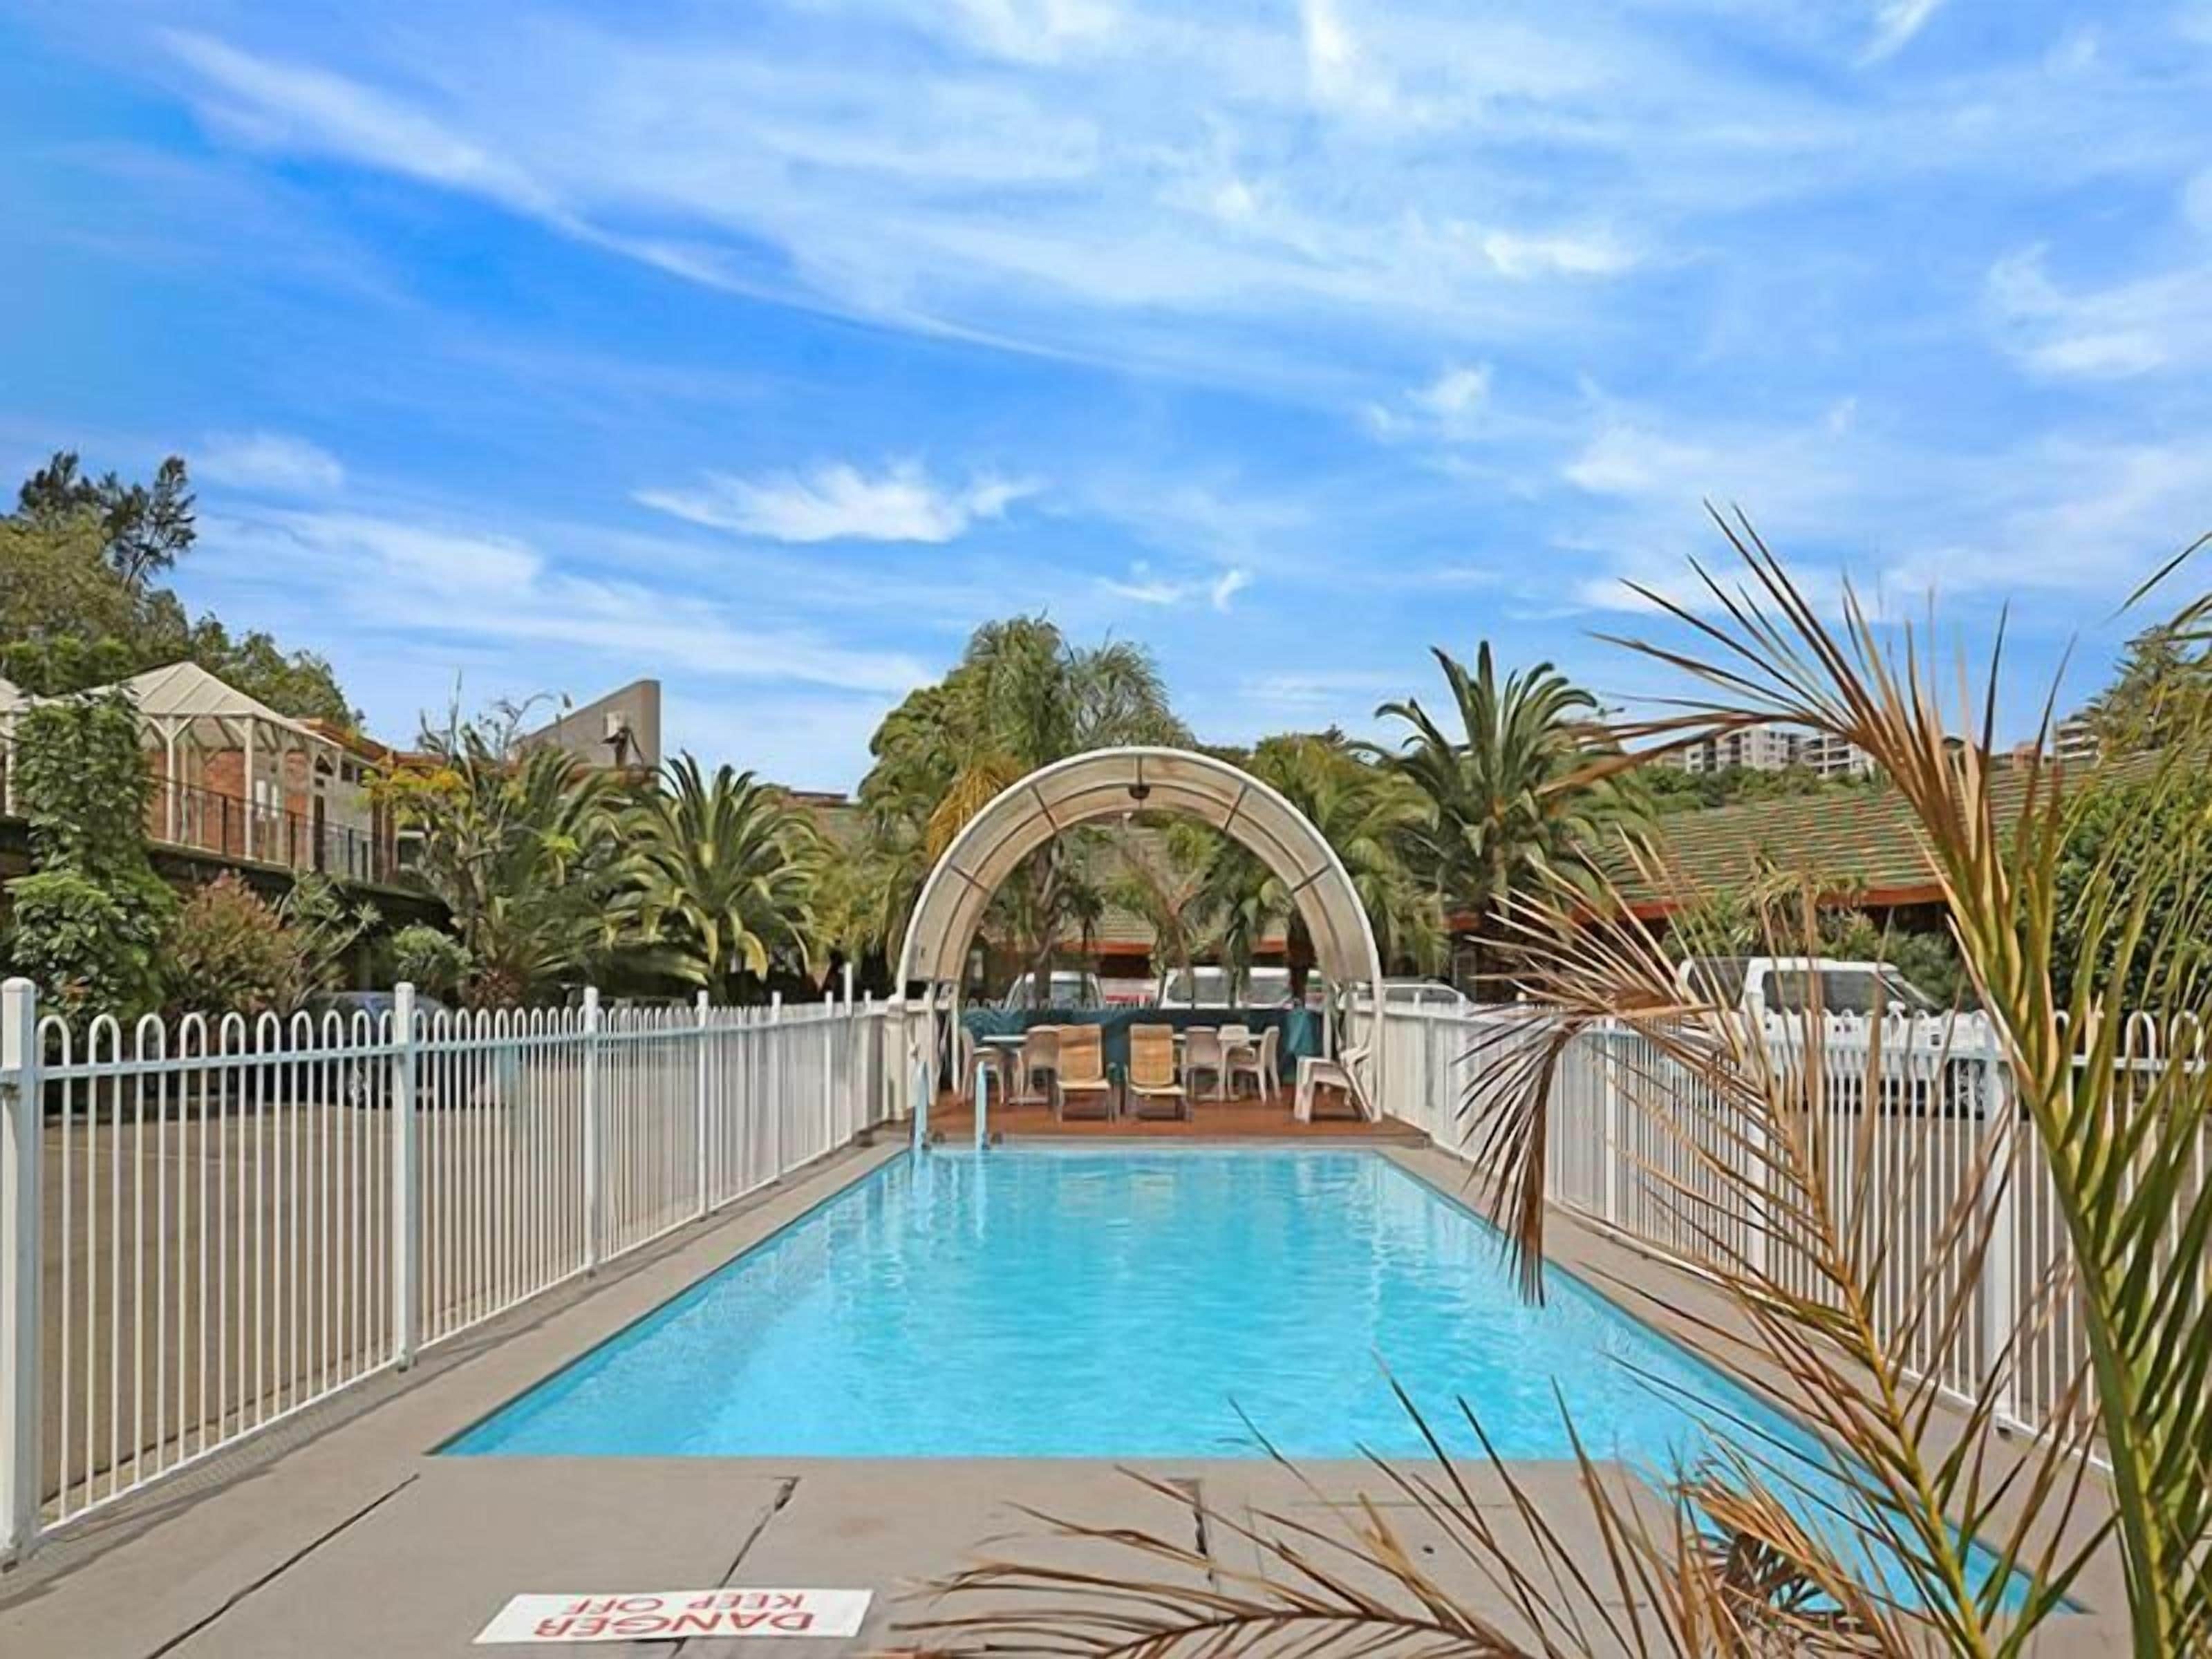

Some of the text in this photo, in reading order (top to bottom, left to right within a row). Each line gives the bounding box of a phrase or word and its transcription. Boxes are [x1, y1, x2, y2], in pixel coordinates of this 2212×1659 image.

[567, 1593, 802, 1615] KEEP OFF
[535, 1613, 814, 1638] DANGER
